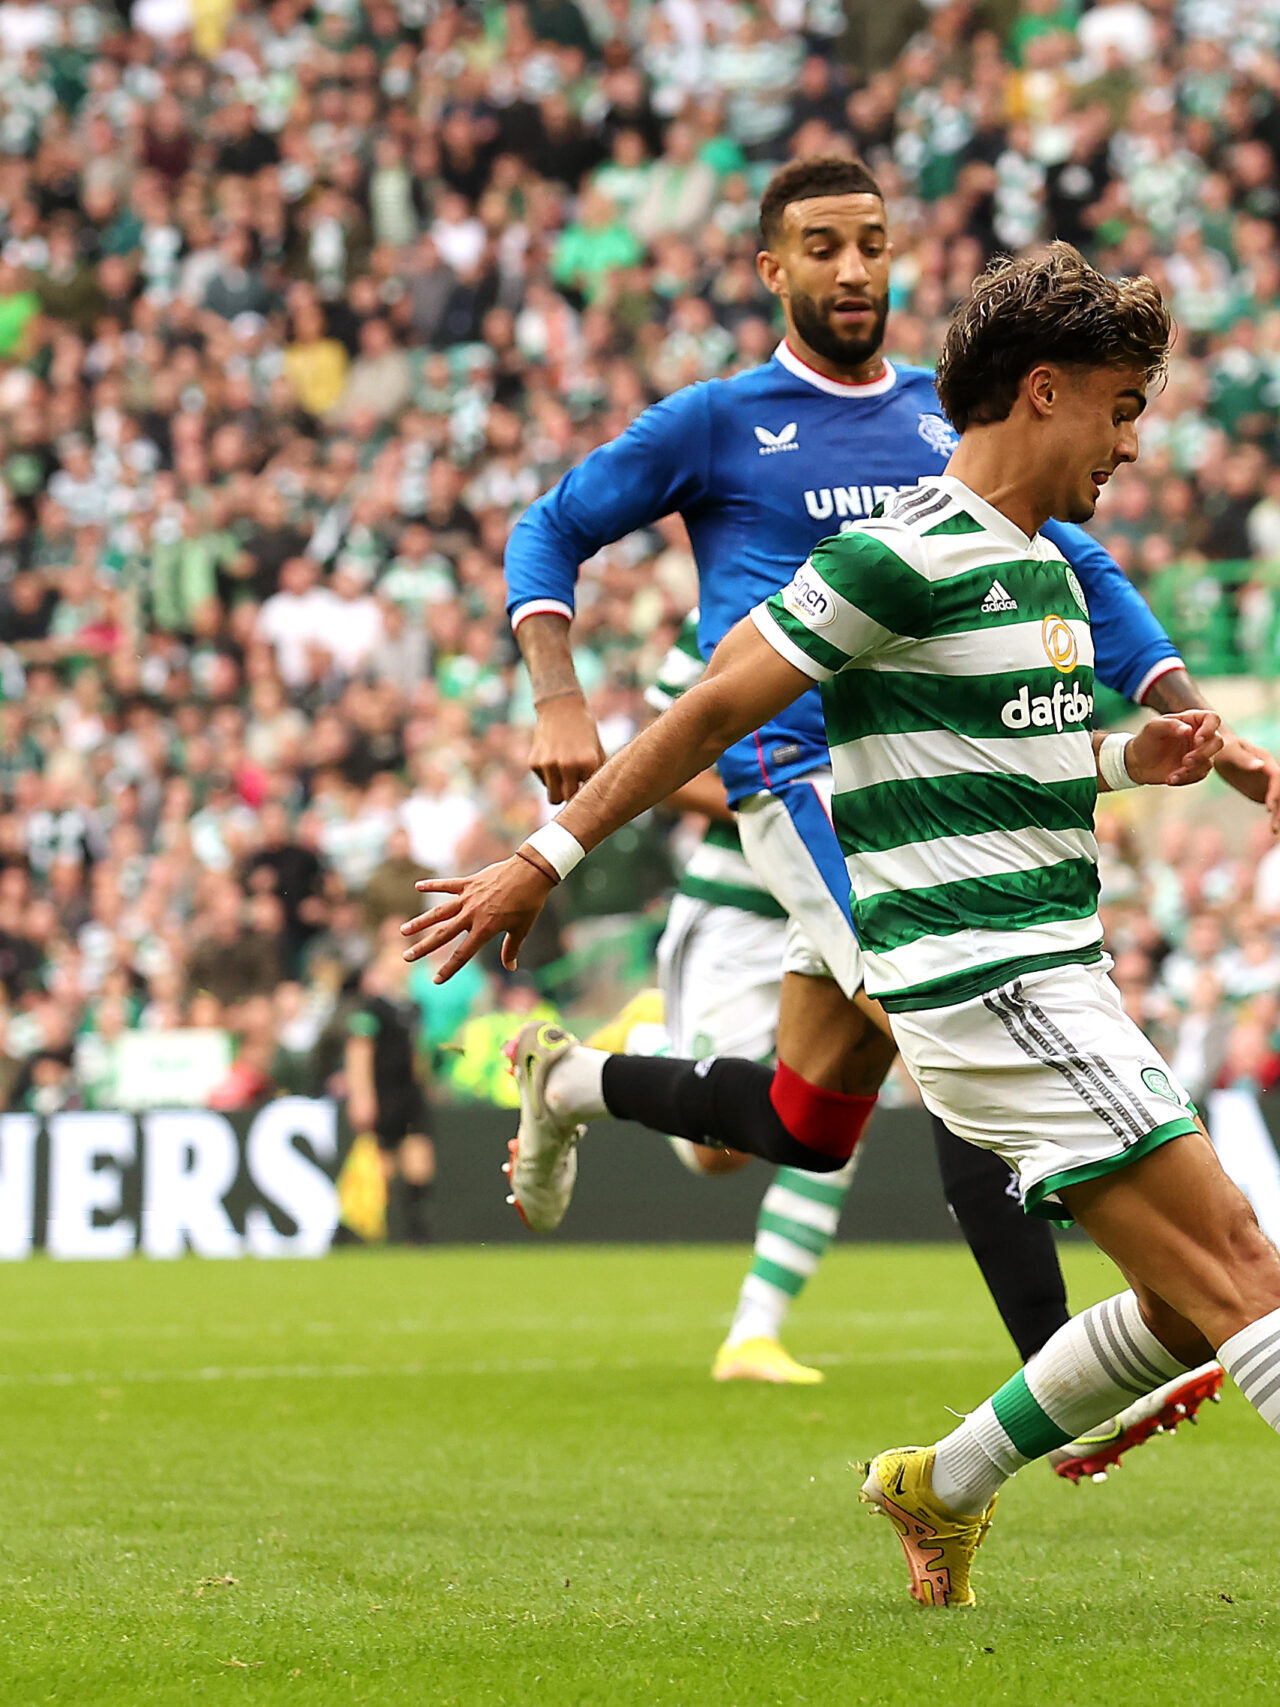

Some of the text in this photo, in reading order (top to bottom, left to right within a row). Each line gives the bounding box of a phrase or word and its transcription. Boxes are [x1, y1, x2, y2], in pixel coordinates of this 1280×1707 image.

[981, 600, 1018, 613] adidas
[1001, 681, 1094, 733] dafab
[0, 1098, 341, 1260] ERS
